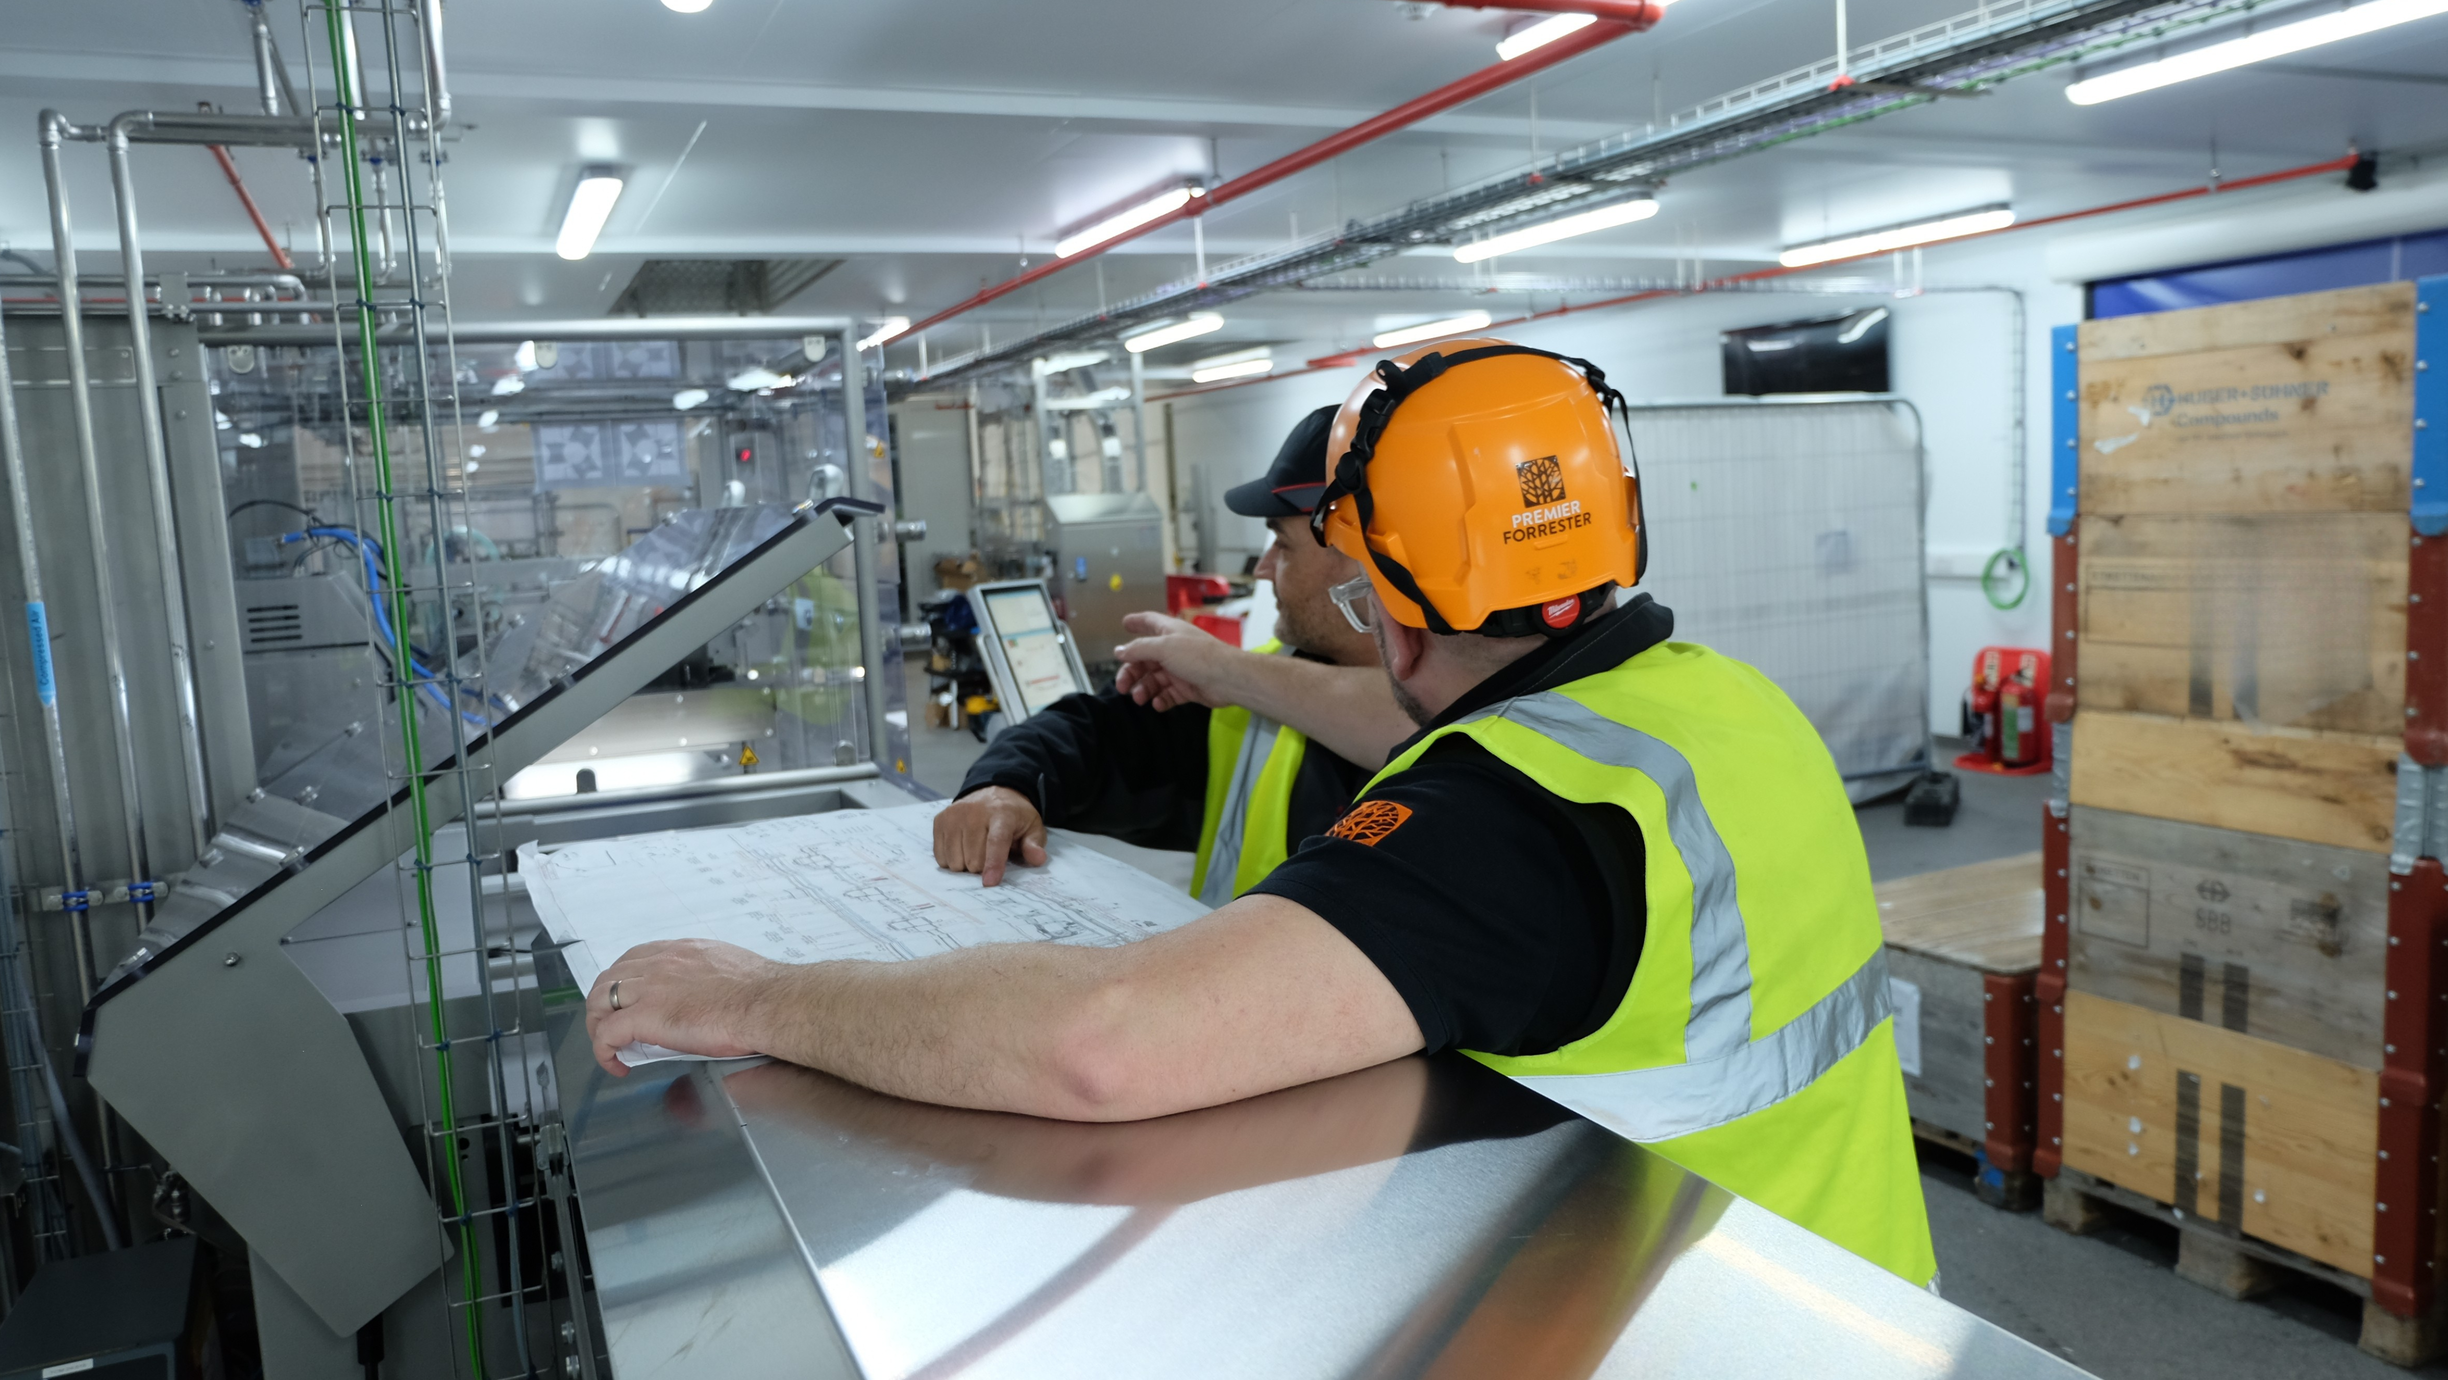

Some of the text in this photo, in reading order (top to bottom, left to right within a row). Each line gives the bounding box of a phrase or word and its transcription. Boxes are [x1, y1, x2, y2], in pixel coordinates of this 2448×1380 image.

[2176, 408, 2280, 428] Compounds
[1502, 512, 1592, 544] FORRESTER
[1511, 500, 1581, 528] PREMIER
[31, 610, 50, 686] Compressed Air
[2195, 907, 2231, 935] SBB
